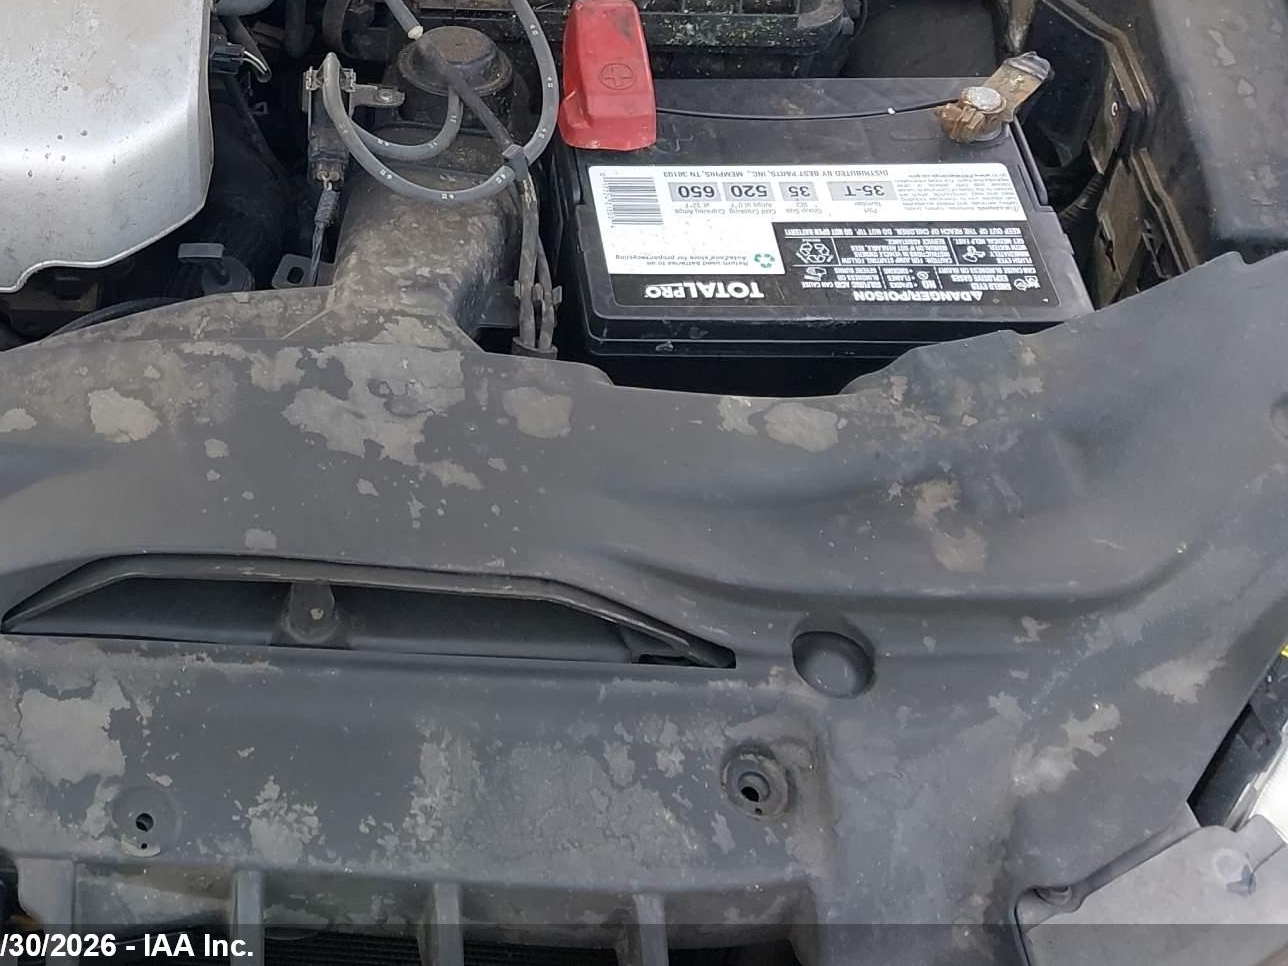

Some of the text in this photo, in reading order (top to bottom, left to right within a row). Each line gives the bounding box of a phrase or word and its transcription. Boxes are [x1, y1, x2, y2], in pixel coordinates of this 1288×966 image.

[678, 185, 715, 198] 650
[730, 185, 768, 198] 520
[788, 185, 810, 197] 35
[844, 185, 885, 196] 35-T
[644, 281, 764, 298] TOTALPRO
[922, 280, 937, 289] NO
